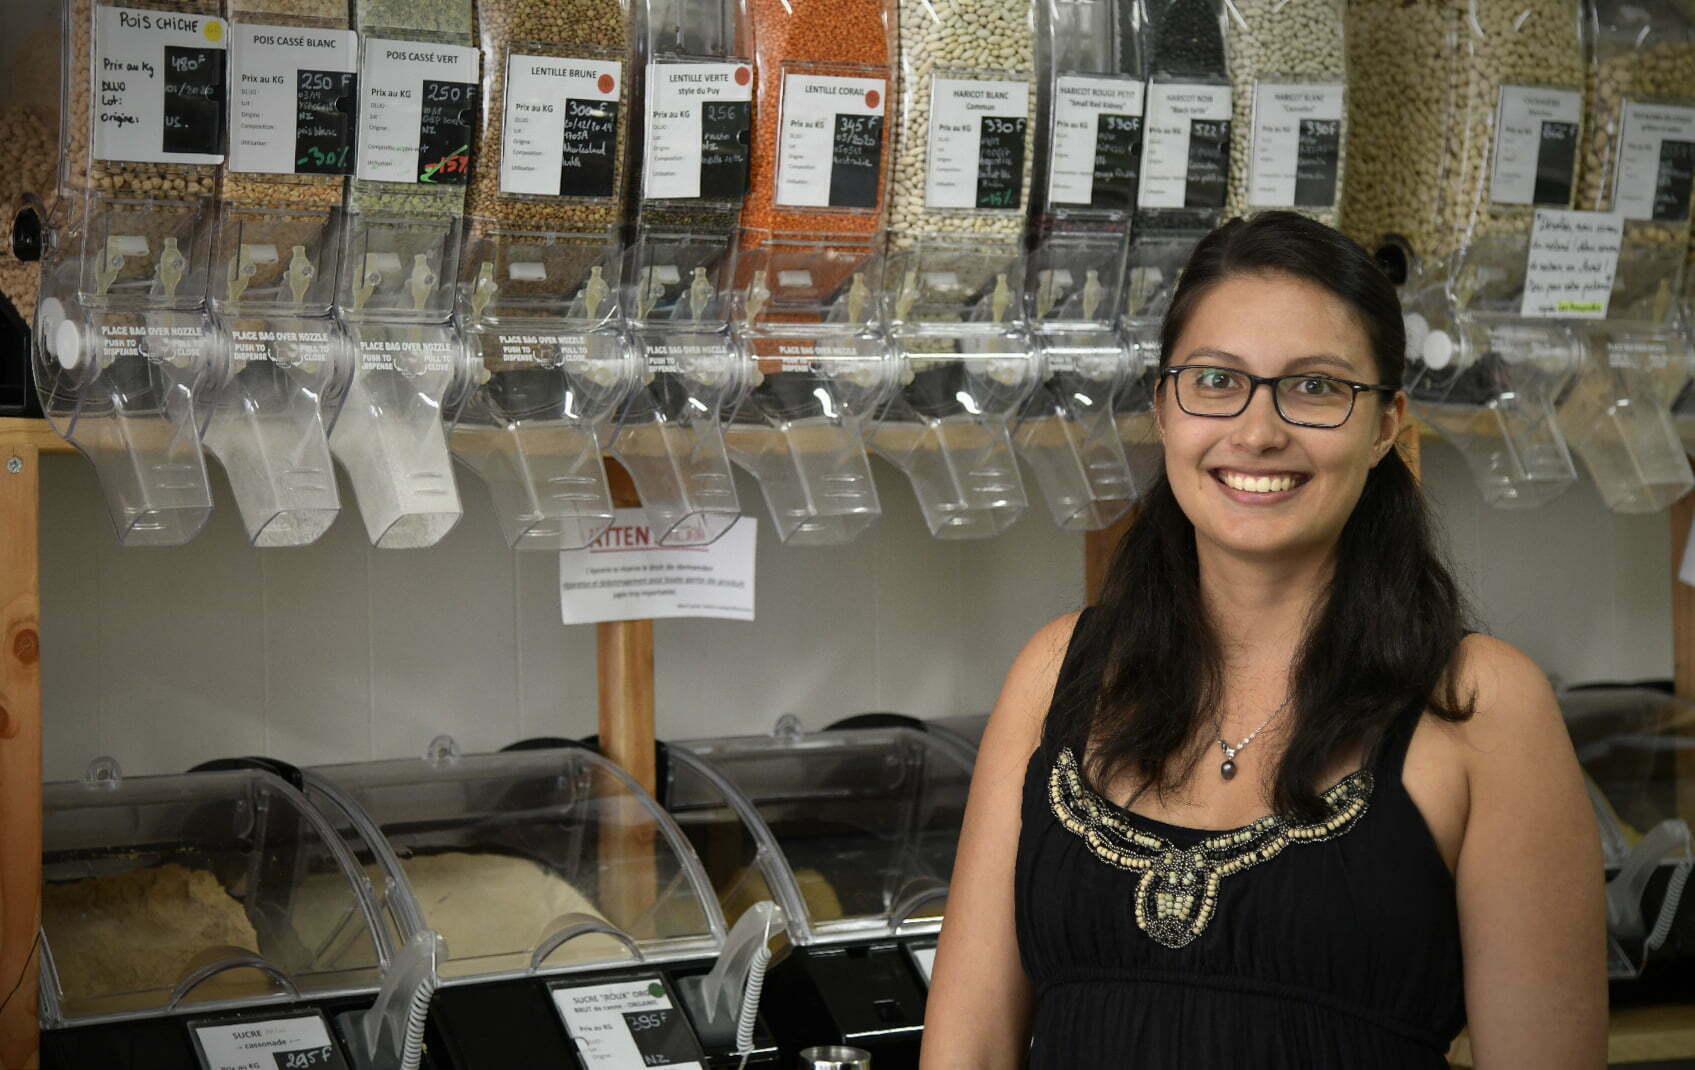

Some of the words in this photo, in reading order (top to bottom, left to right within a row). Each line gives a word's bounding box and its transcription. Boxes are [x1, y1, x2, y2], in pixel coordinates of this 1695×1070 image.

[253, 35, 274, 46] POIS
[277, 36, 304, 47] CASSÉ
[306, 39, 337, 49] BLANC
[386, 51, 406, 61] POIS
[408, 52, 435, 63] CASSÉ
[436, 54, 458, 64] VERT
[103, 58, 123, 71] Prix
[126, 63, 139, 71] au
[531, 66, 567, 77] LENTILLE
[569, 69, 598, 79] BRUNE
[241, 74, 258, 84] Prix
[259, 76, 270, 84] au
[272, 76, 284, 84] KG
[301, 72, 332, 90] 250
[669, 74, 702, 83] LENTILLE
[704, 74, 729, 82] VERTE
[371, 88, 386, 98] Prix
[388, 90, 398, 98] au
[400, 89, 412, 98] KG
[427, 83, 461, 101] 250
[678, 88, 694, 96] style
[696, 87, 706, 95] du
[707, 87, 720, 96] Puy
[805, 85, 837, 95] LENTILLE
[953, 90, 985, 99] HARICOT
[1060, 87, 1091, 96] HARICOT
[1092, 89, 1116, 97] ROUGE
[515, 103, 530, 112] Prix
[531, 105, 541, 113] au
[542, 104, 554, 113] KG
[966, 103, 995, 111] Commun
[653, 111, 668, 119] Prix
[680, 110, 690, 119] KG
[790, 120, 803, 128] Prix
[815, 121, 825, 129] KG
[101, 326, 129, 336] PLACE
[129, 327, 146, 336] BAG
[147, 327, 170, 336] OVER
[171, 327, 202, 337] NOZZLE
[232, 331, 258, 340] PLACE
[258, 331, 275, 341] BAG
[276, 332, 297, 341] OVER
[298, 332, 328, 342] NOZZLE
[104, 339, 124, 348] PUSH
[126, 339, 137, 348] TO
[499, 336, 522, 344] PLACE
[522, 336, 538, 344] BAG
[558, 337, 584, 345] NOZZLE
[235, 343, 254, 352] PUSH
[255, 344, 266, 352] TO
[360, 341, 384, 351] PLACE
[385, 342, 401, 351] BAG
[401, 342, 422, 351] OVER
[422, 342, 451, 351] NOZZLE
[232, 1030, 262, 1040] SUCRE
